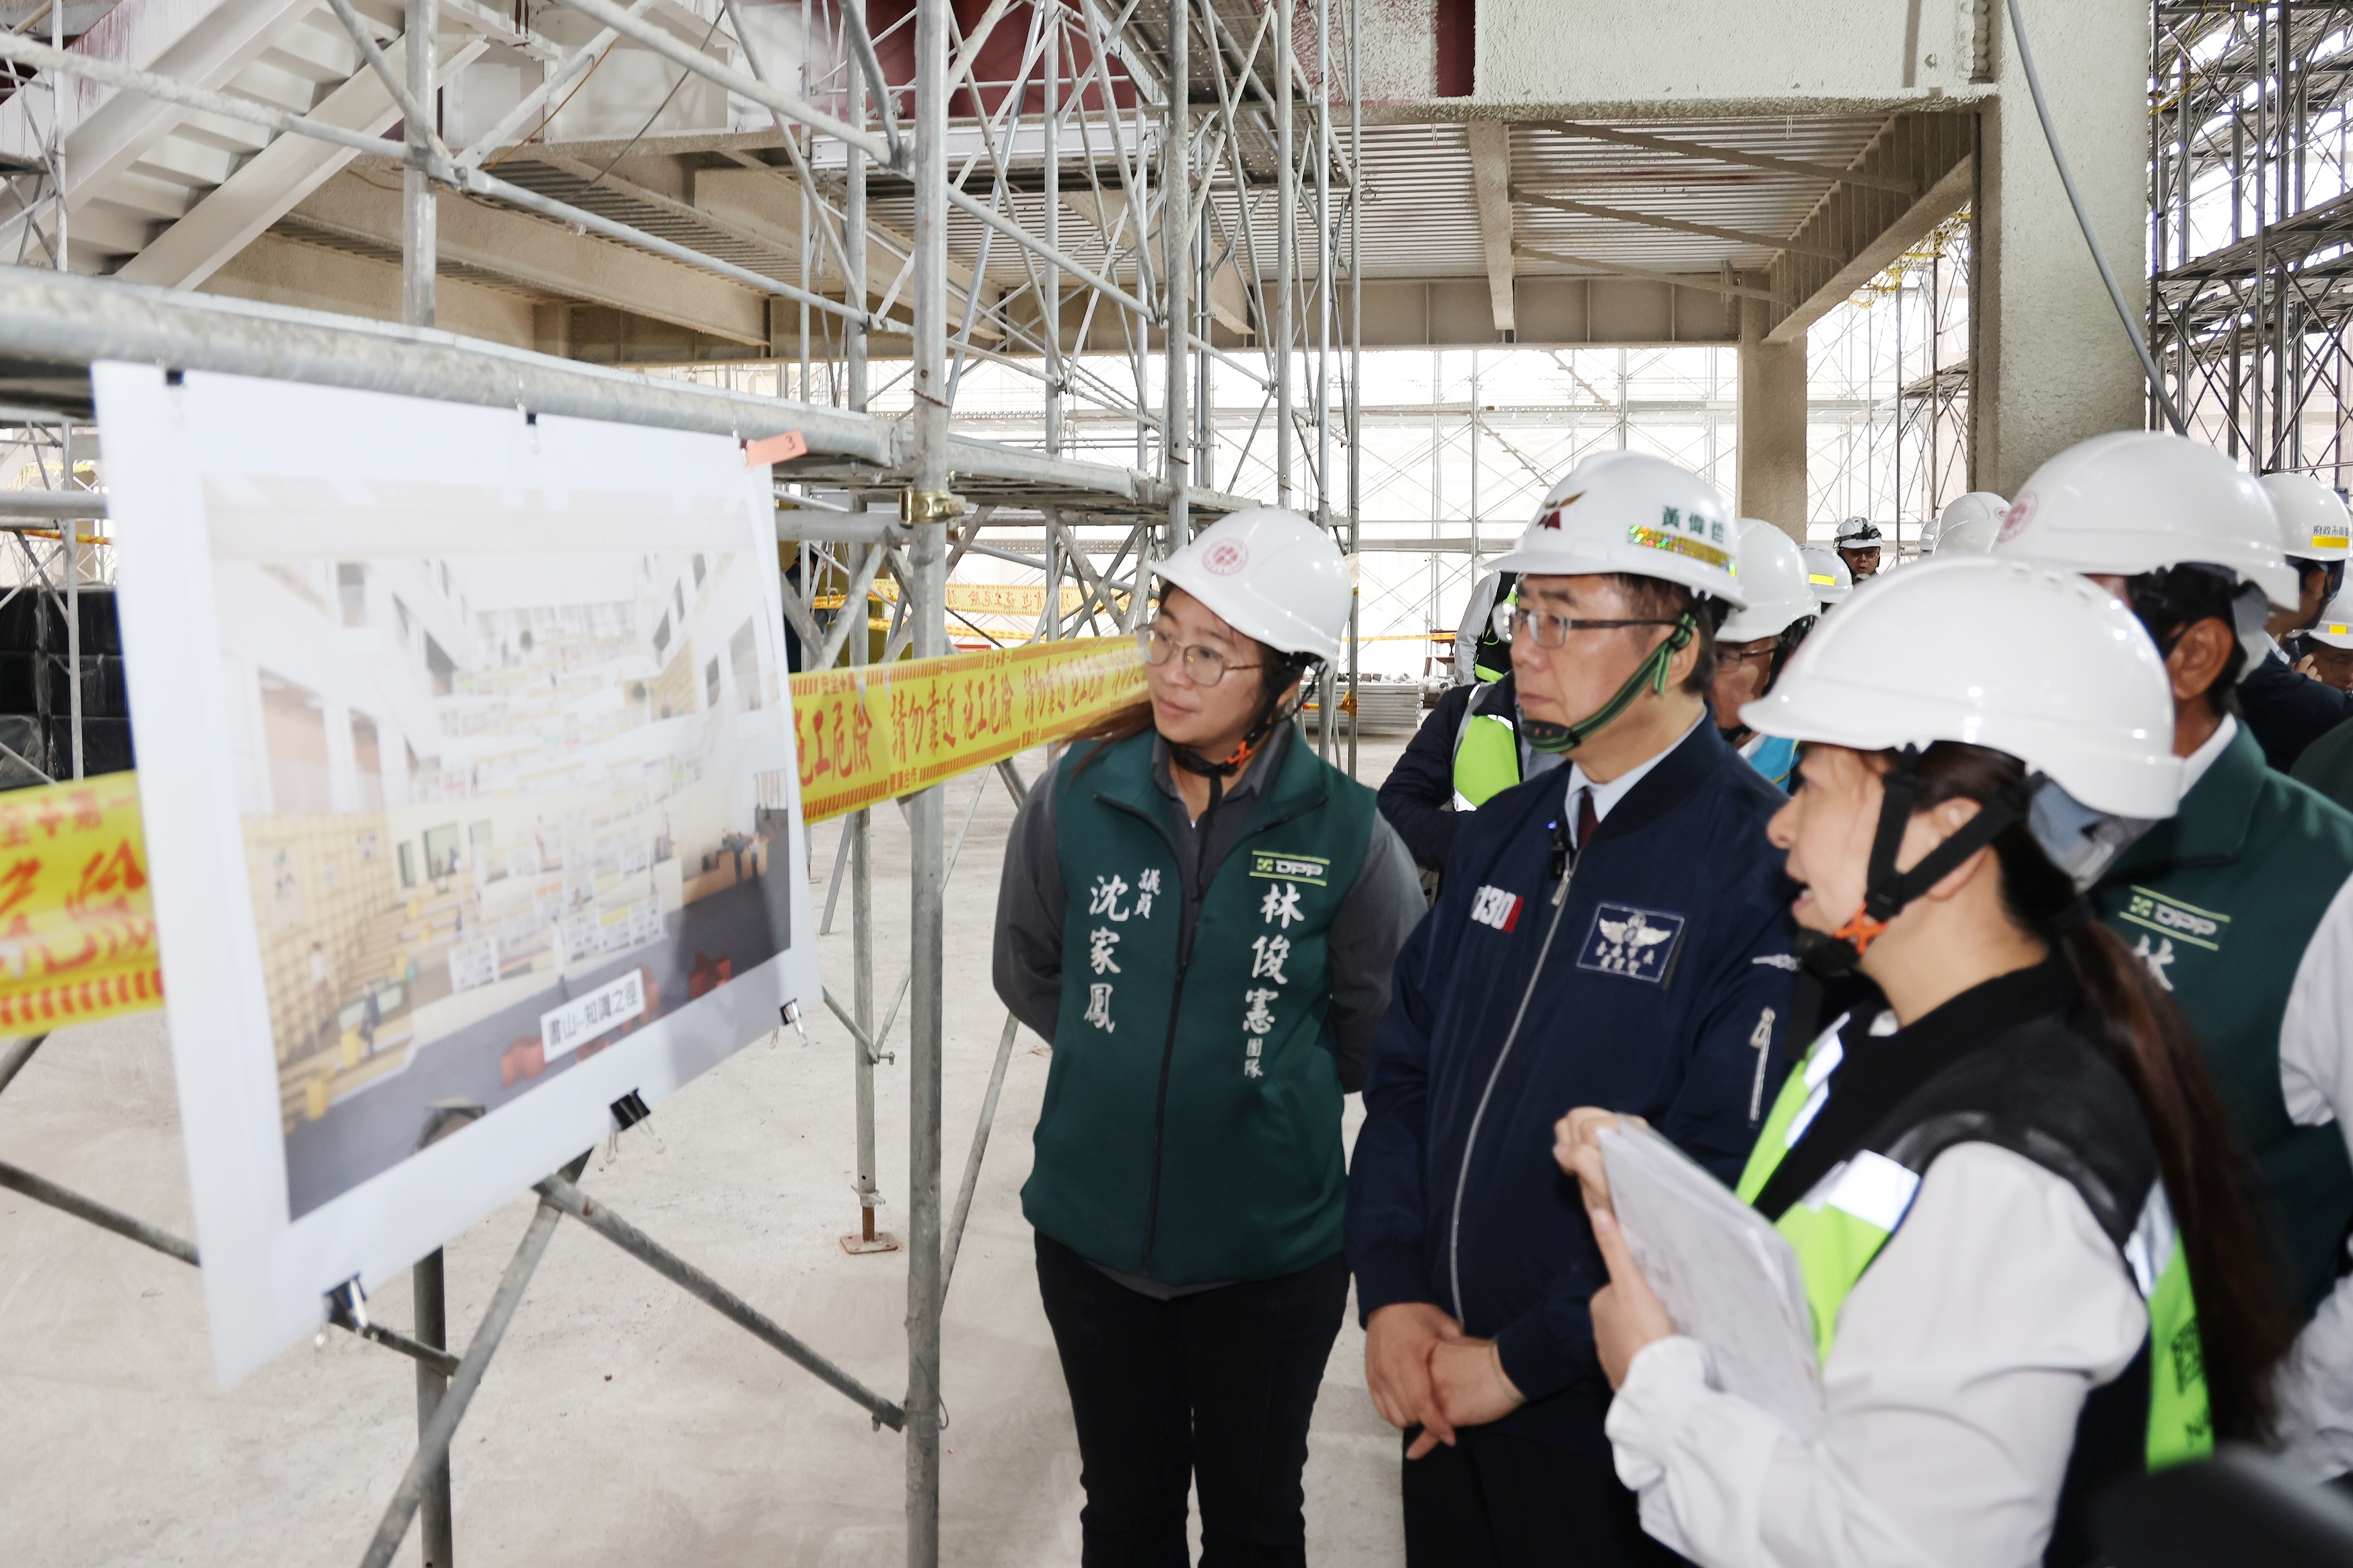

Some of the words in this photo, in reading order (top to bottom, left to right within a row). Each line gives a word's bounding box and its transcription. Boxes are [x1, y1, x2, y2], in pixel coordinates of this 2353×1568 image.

[890, 679, 957, 764] 請勿靠近
[962, 672, 1014, 741] 施工危險
[1275, 860, 1324, 877] DPP
[2154, 902, 2218, 936] DPP
[1084, 874, 1130, 1034] 沈家鳳
